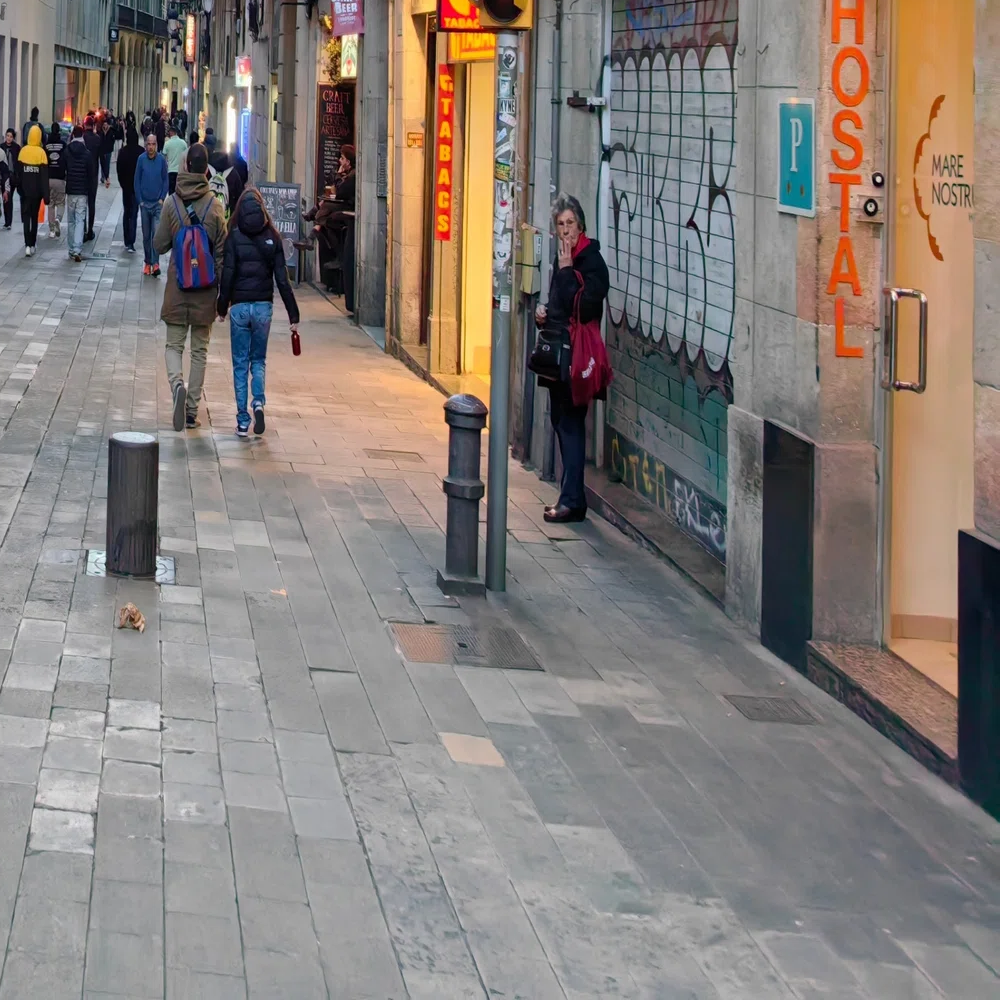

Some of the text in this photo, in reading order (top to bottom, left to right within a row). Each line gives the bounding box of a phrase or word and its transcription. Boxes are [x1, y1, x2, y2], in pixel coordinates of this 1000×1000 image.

[334, 1, 358, 14] BEER
[322, 89, 350, 104] CRAFT
[437, 98, 452, 233] TABACS
[932, 154, 964, 178] MARE
